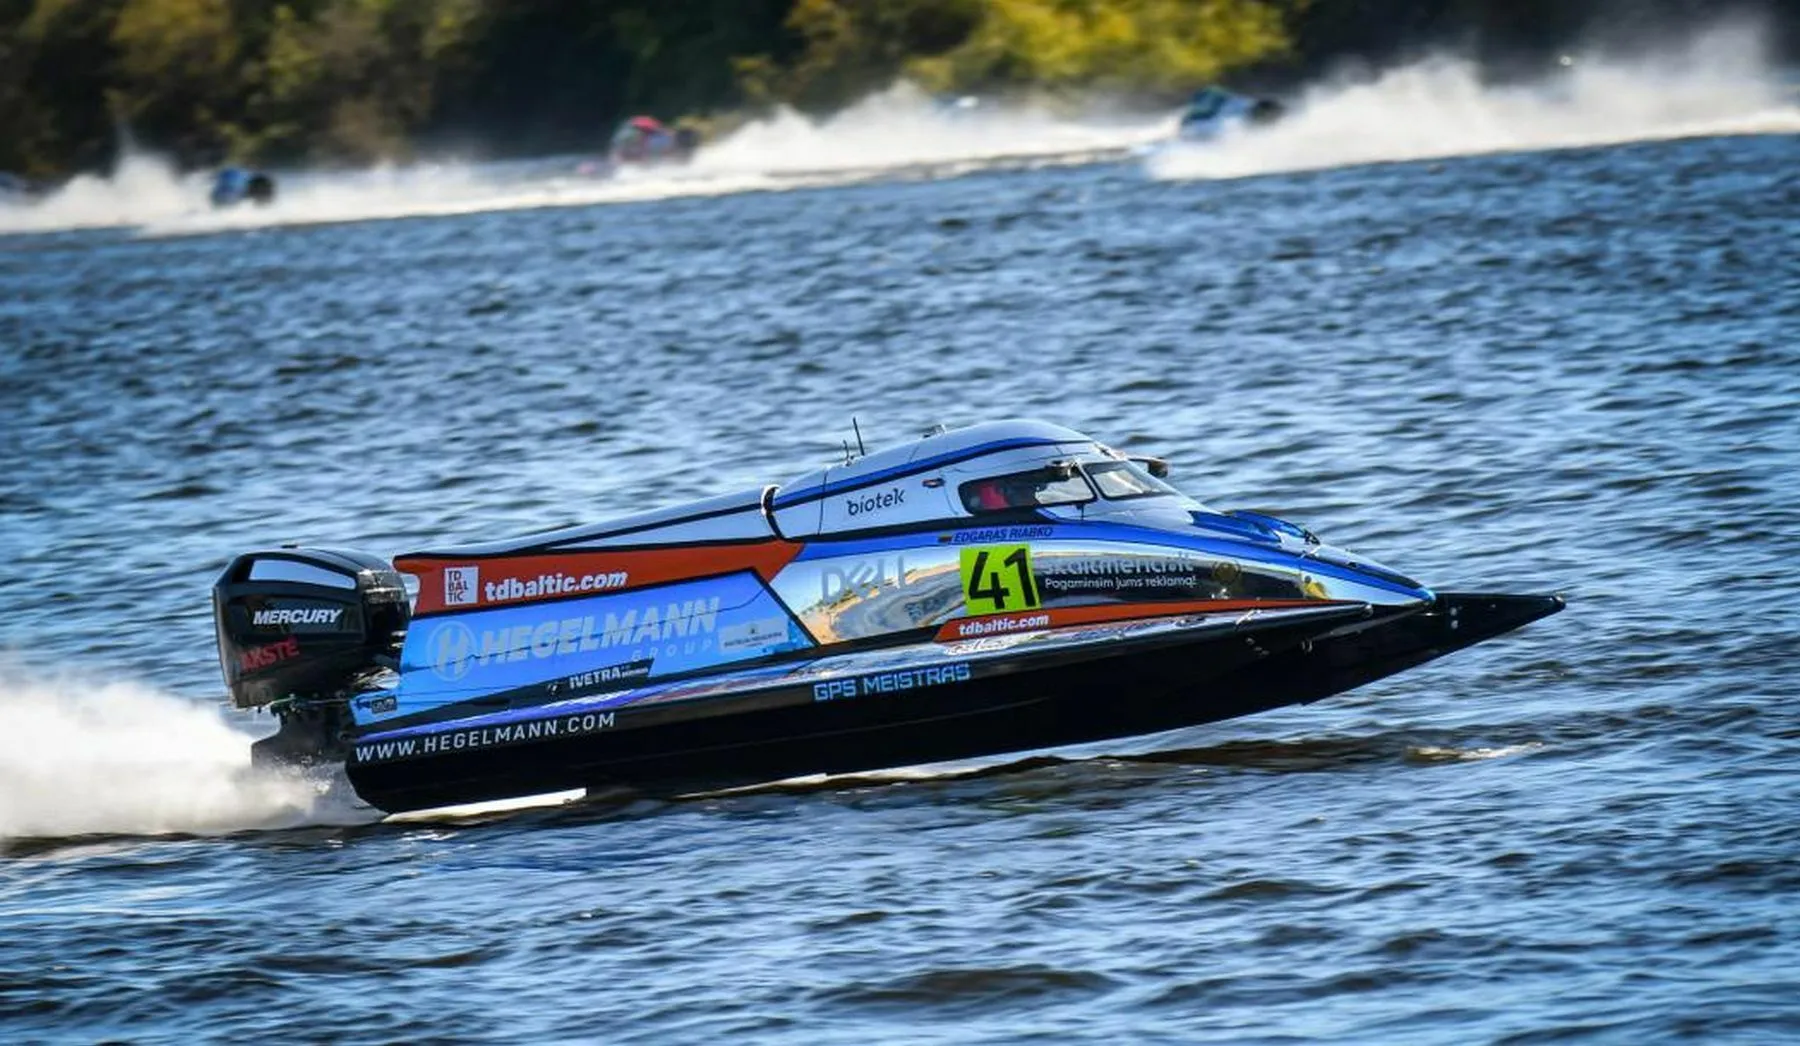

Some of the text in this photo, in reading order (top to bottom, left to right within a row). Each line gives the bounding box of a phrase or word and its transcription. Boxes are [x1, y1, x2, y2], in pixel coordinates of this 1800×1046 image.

[846, 487, 906, 516] biotek
[953, 528, 1008, 542] EDGARAS
[448, 570, 462, 581] TD
[448, 581, 468, 591] BAL
[484, 571, 629, 601] tdbaltic.com
[821, 555, 906, 604] DELL
[968, 548, 1036, 609] 41
[448, 591, 465, 602] TIC
[252, 608, 344, 625] MERCURY
[959, 615, 1049, 636] tdbaltic.com
[477, 597, 721, 666] HEGELMANN
[569, 666, 621, 689] IVETRA
[813, 662, 971, 701] GPS MEISTRAS
[355, 711, 616, 763] WWW.HEGELMANN.COM
